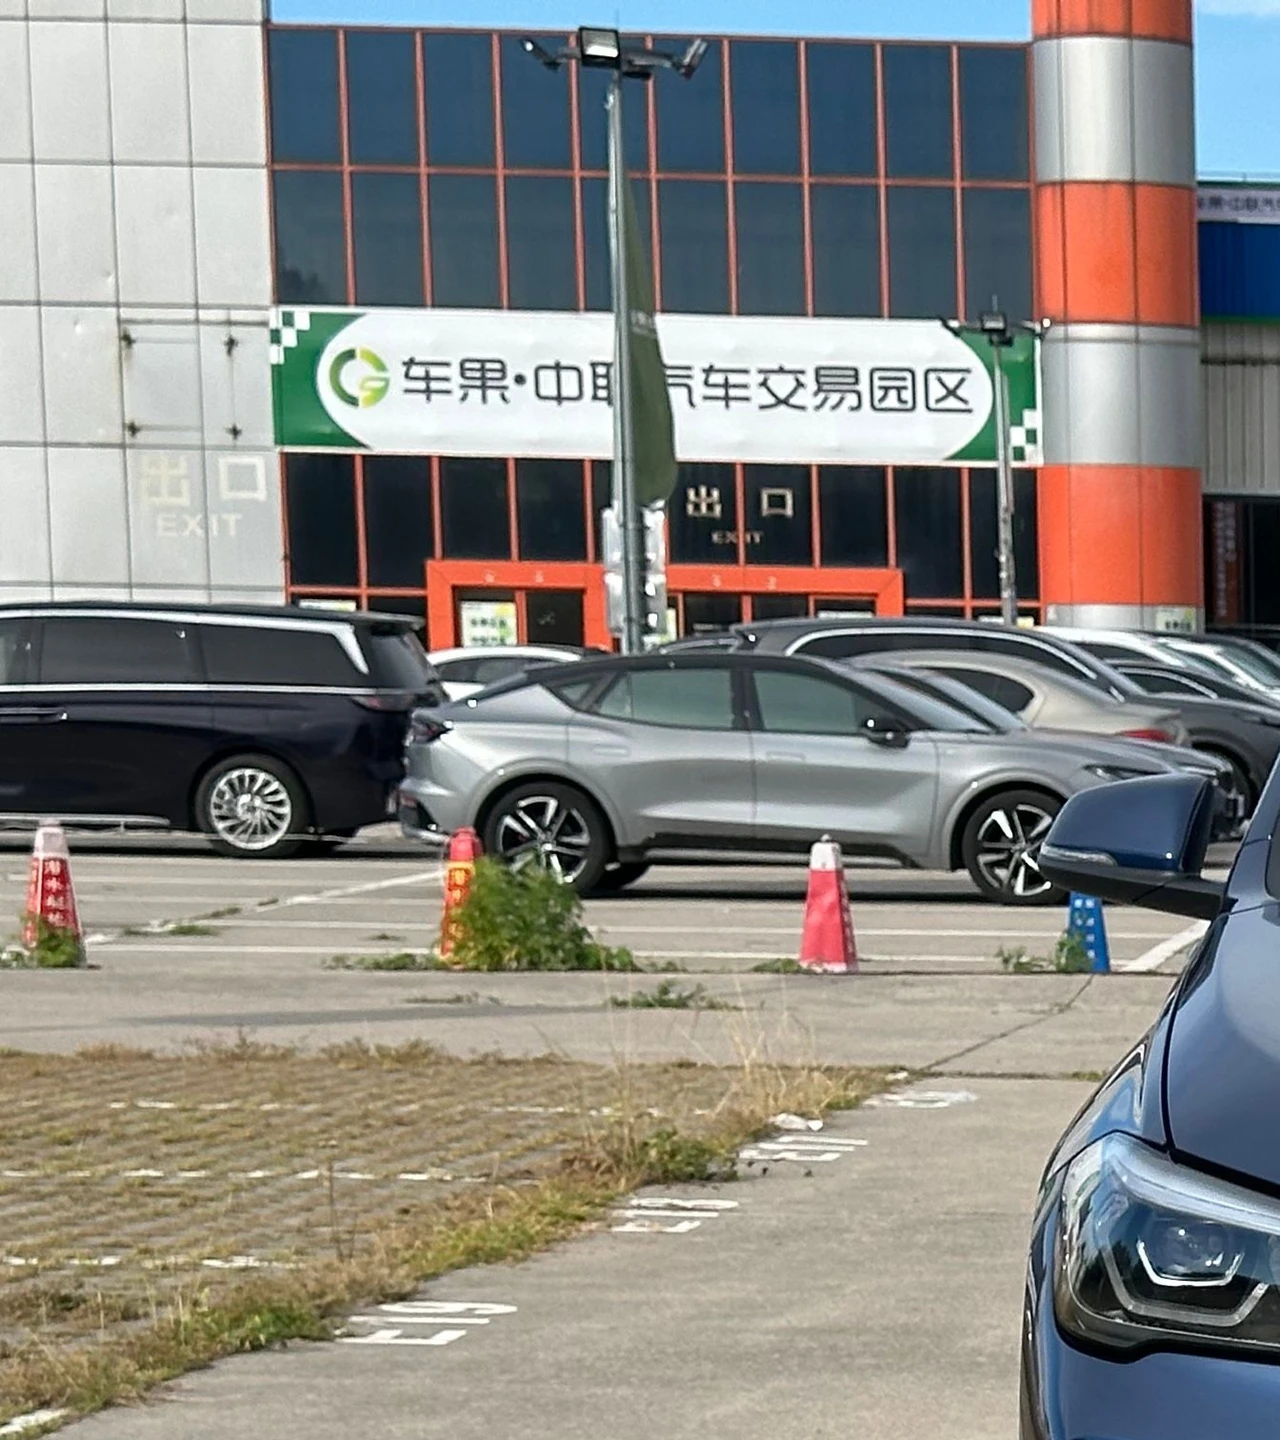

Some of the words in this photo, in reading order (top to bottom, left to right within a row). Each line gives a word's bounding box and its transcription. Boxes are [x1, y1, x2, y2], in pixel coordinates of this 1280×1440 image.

[139, 455, 268, 506] 出口
[686, 485, 794, 518] 出口
[157, 513, 243, 538] EXIT
